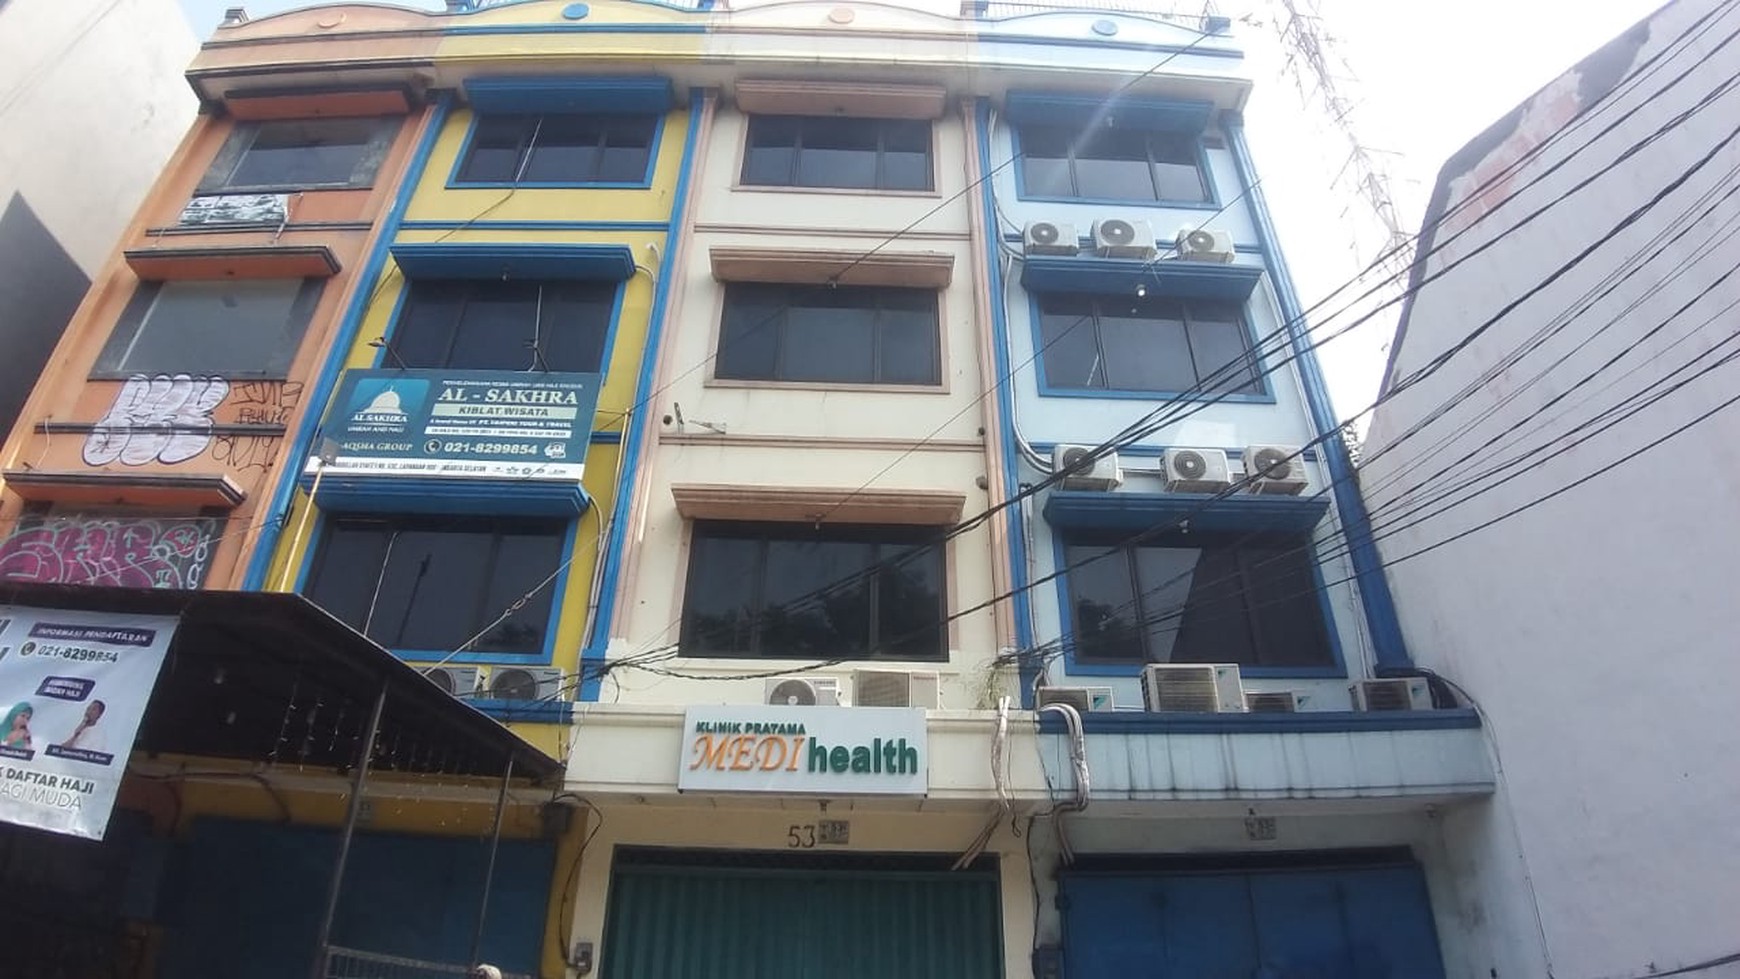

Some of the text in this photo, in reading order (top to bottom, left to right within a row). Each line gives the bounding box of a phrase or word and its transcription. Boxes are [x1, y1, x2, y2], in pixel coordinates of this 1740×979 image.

[439, 388, 467, 401] AL
[485, 389, 578, 405] SAKHRA
[458, 406, 549, 417] KIBLAT WISATA
[376, 442, 413, 451] GROUP
[444, 442, 537, 455] 021-8299854
[696, 721, 806, 735] KLINIK PRATAMA
[6, 767, 58, 788] DAFTAR
[60, 778, 95, 794] HAJI
[29, 788, 82, 811] MUDA
[788, 825, 815, 848] 53
